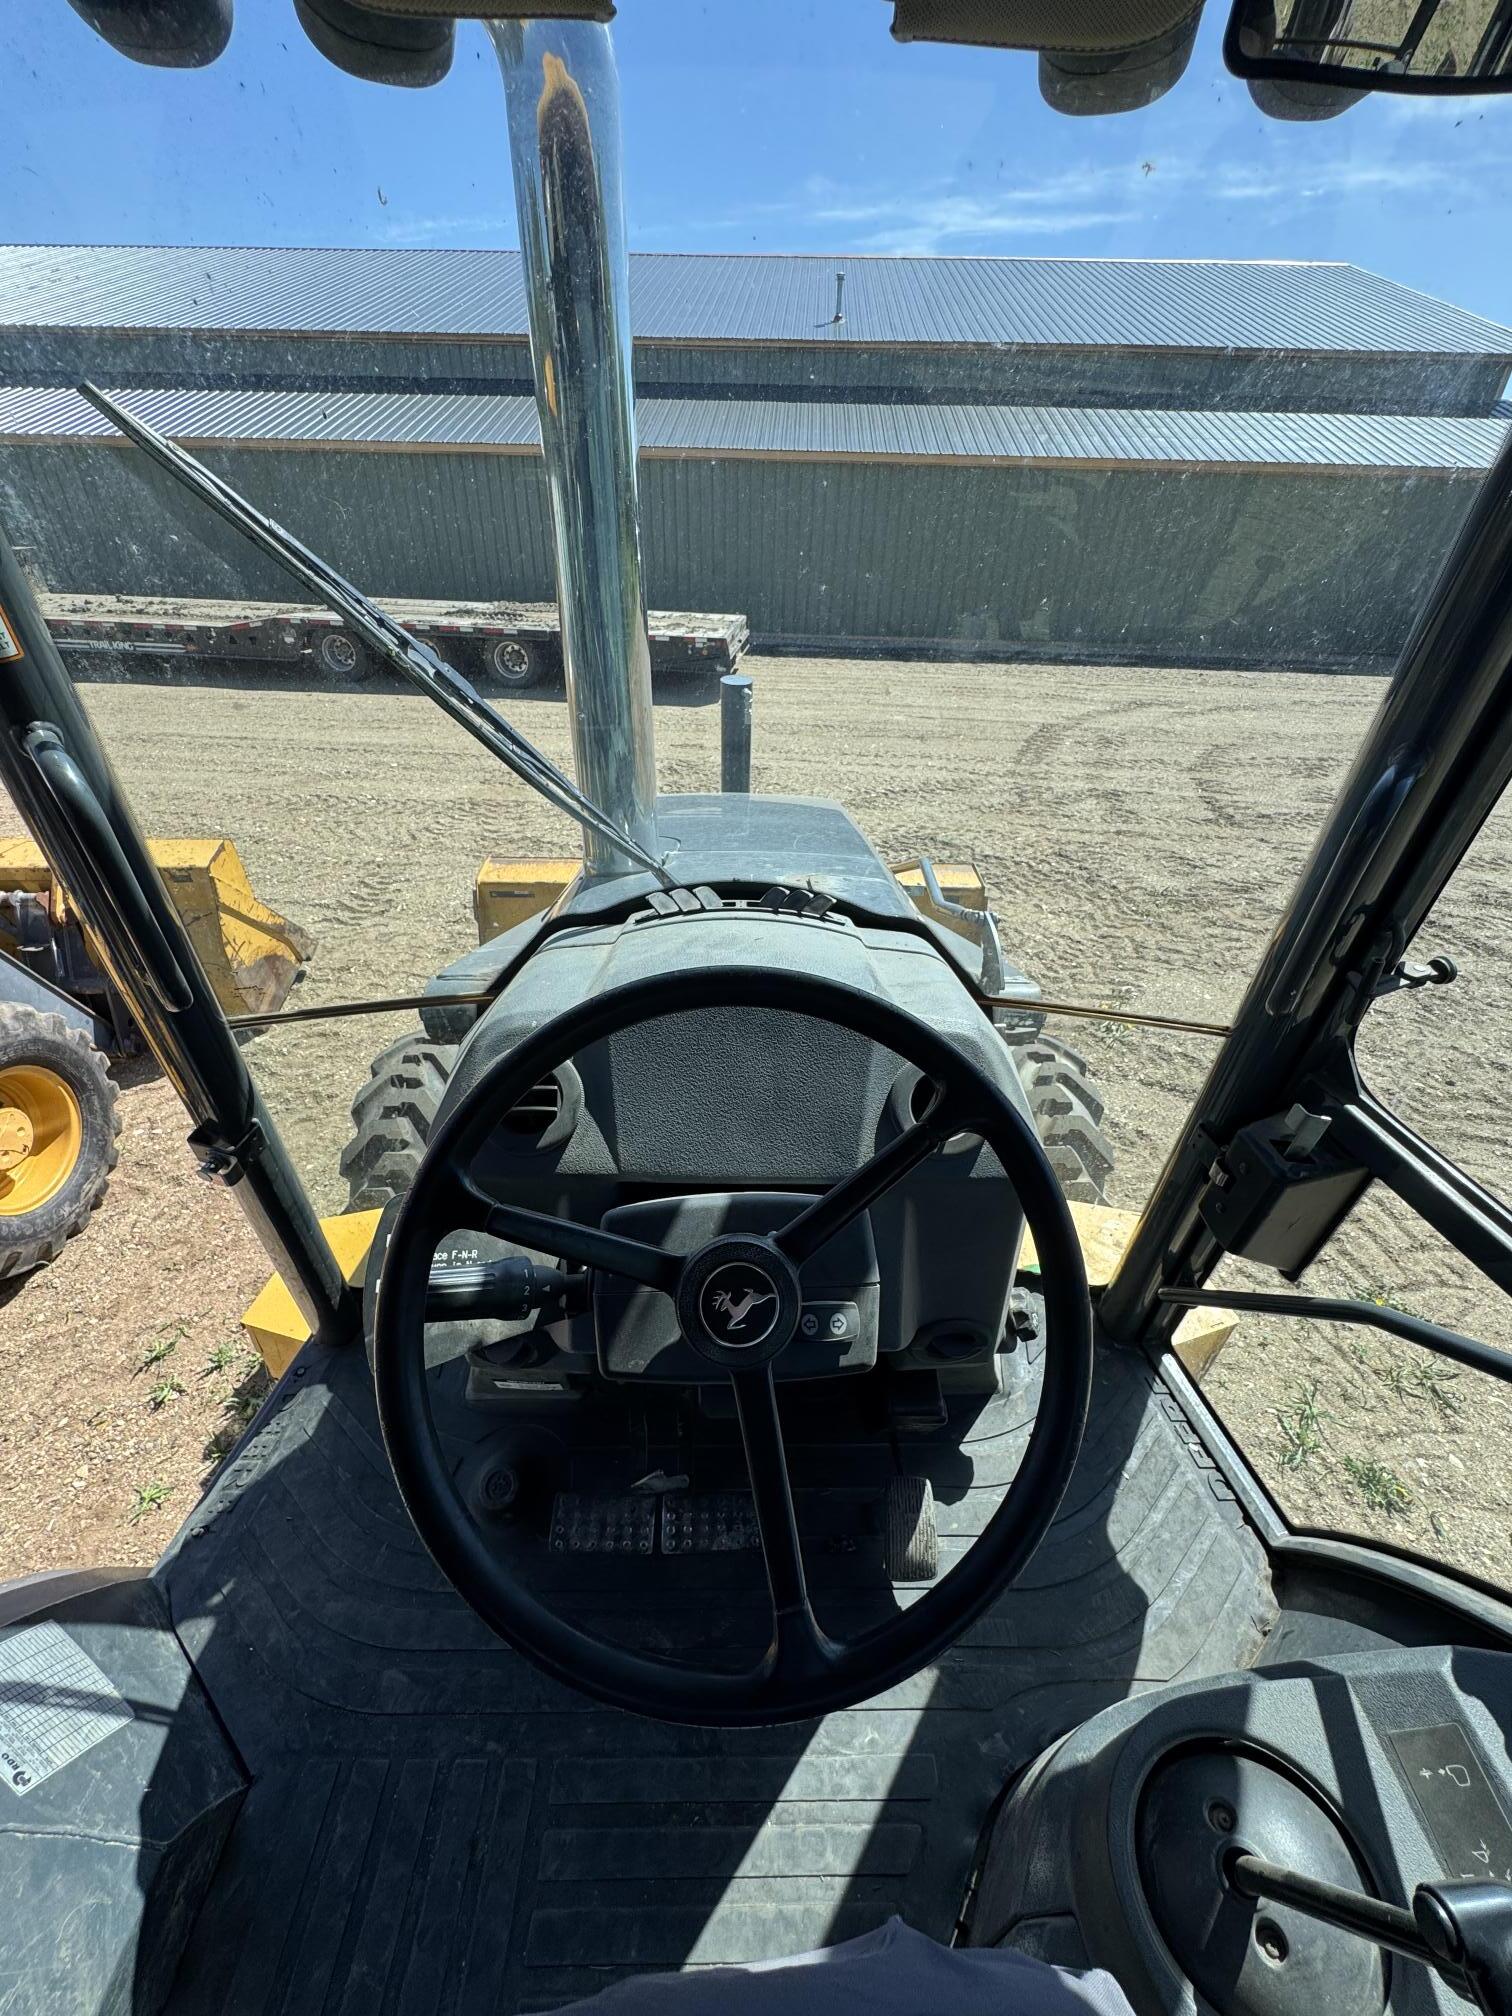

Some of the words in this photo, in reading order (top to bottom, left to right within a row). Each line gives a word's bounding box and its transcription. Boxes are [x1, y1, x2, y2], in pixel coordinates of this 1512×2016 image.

[451, 1249, 478, 1260] F-N-R
[523, 1285, 530, 1296] 2
[521, 1303, 528, 1312] 3
[1, 1752, 20, 1771] RDO
